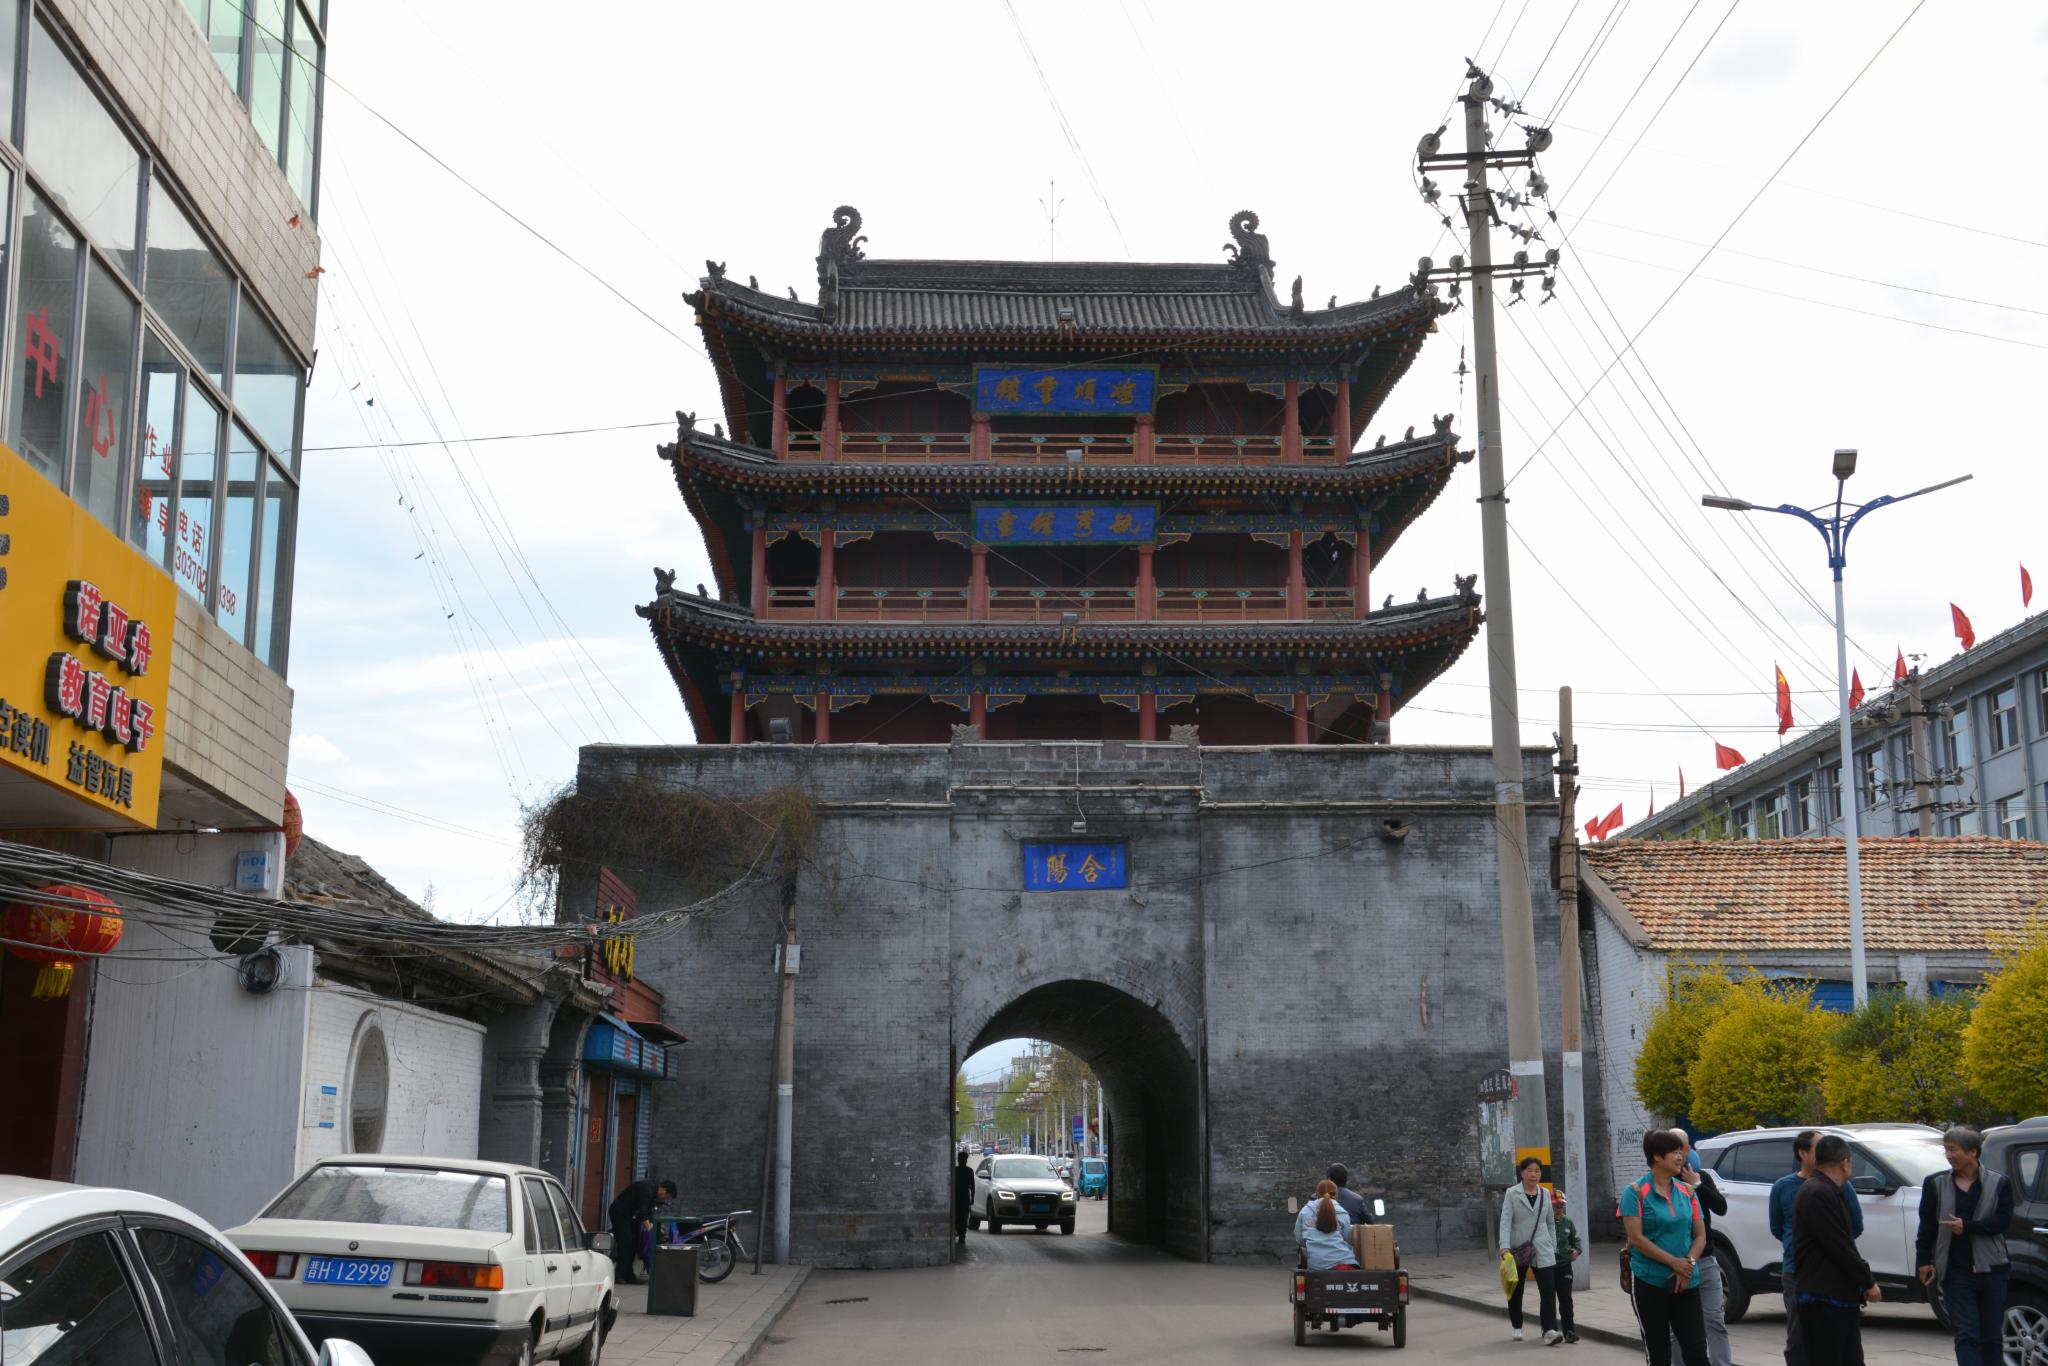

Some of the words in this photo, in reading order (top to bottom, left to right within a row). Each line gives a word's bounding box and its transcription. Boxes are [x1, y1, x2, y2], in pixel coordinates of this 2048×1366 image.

[143, 423, 174, 479] 作业
[178, 508, 203, 557] 电话
[77, 580, 153, 676] 诺亚舟
[58, 652, 155, 753] 教育电子
[67, 739, 134, 808] 益智玩具
